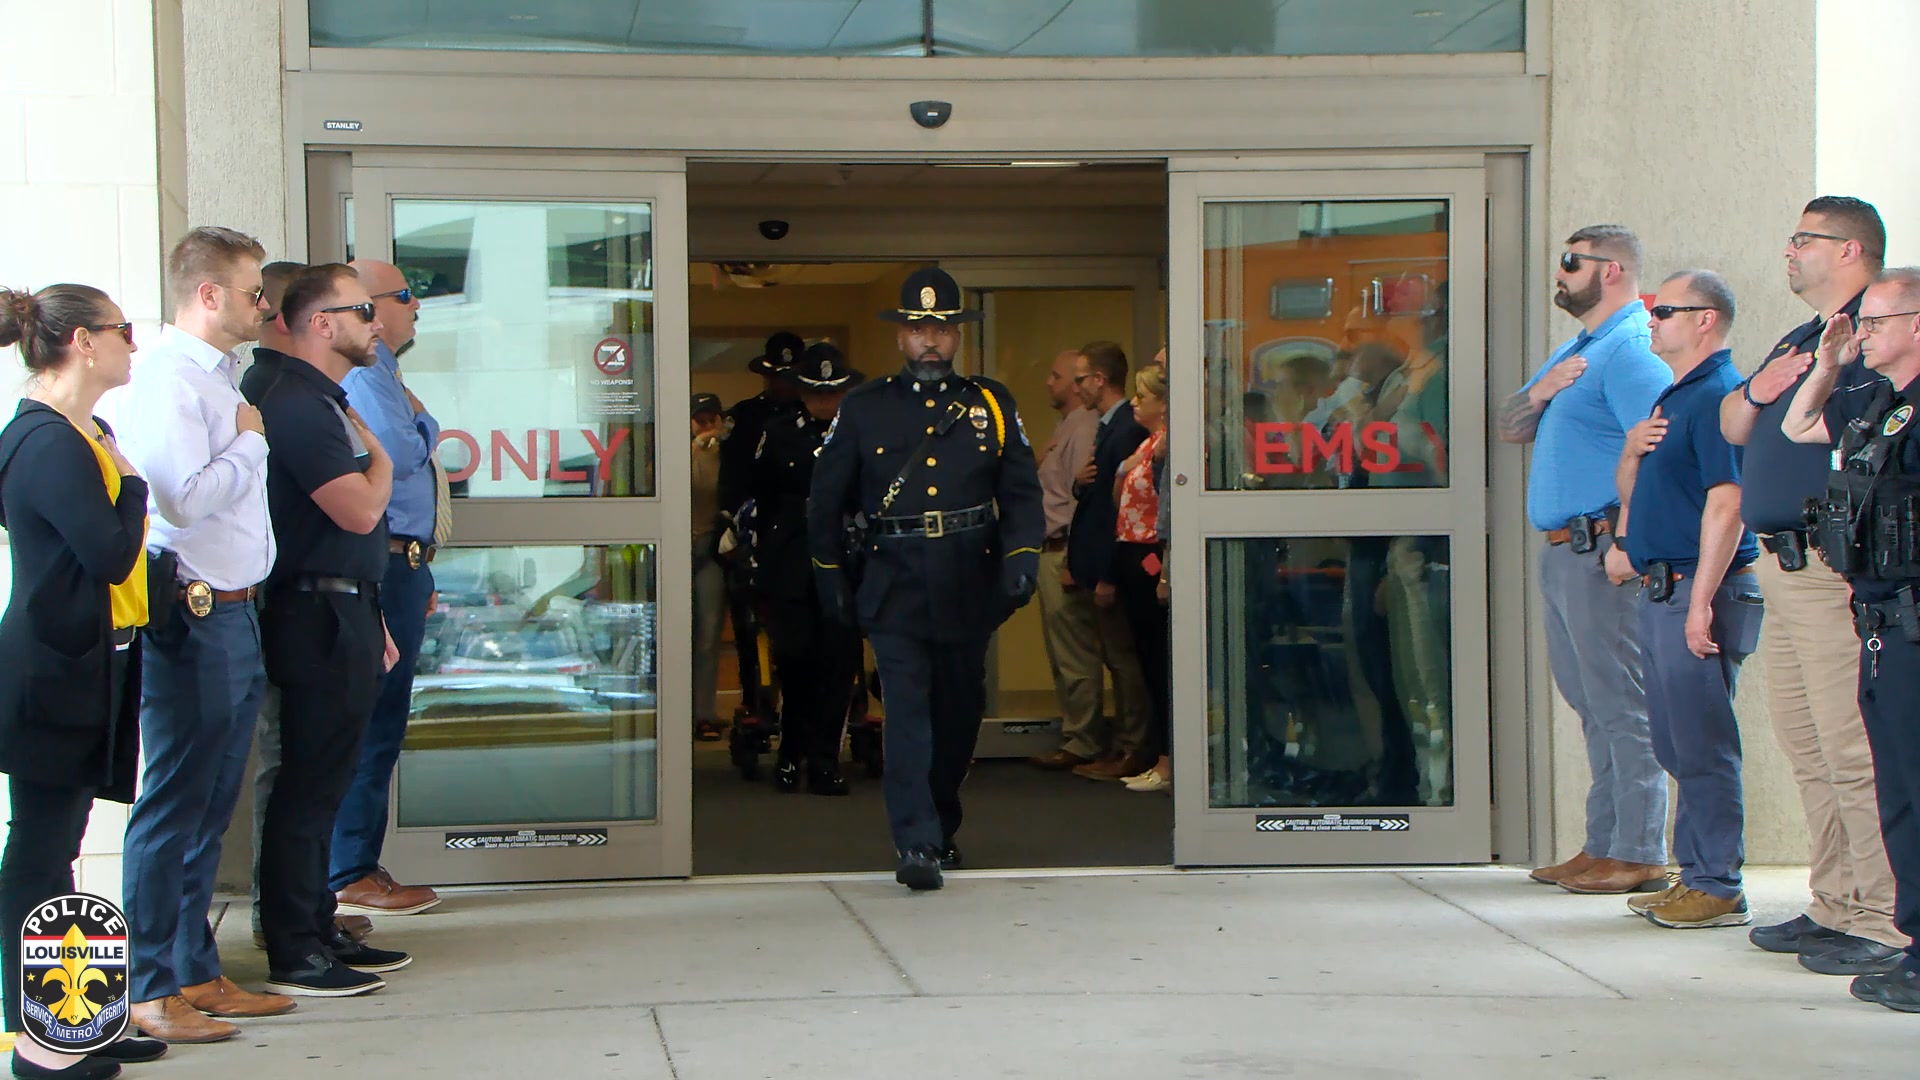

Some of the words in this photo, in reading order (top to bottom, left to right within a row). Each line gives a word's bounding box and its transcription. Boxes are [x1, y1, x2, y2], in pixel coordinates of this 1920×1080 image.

[433, 429, 630, 483] ONLY
[1255, 421, 1400, 474] EMS
[560, 833, 577, 841] DOOR
[1364, 818, 1380, 826] DOOR
